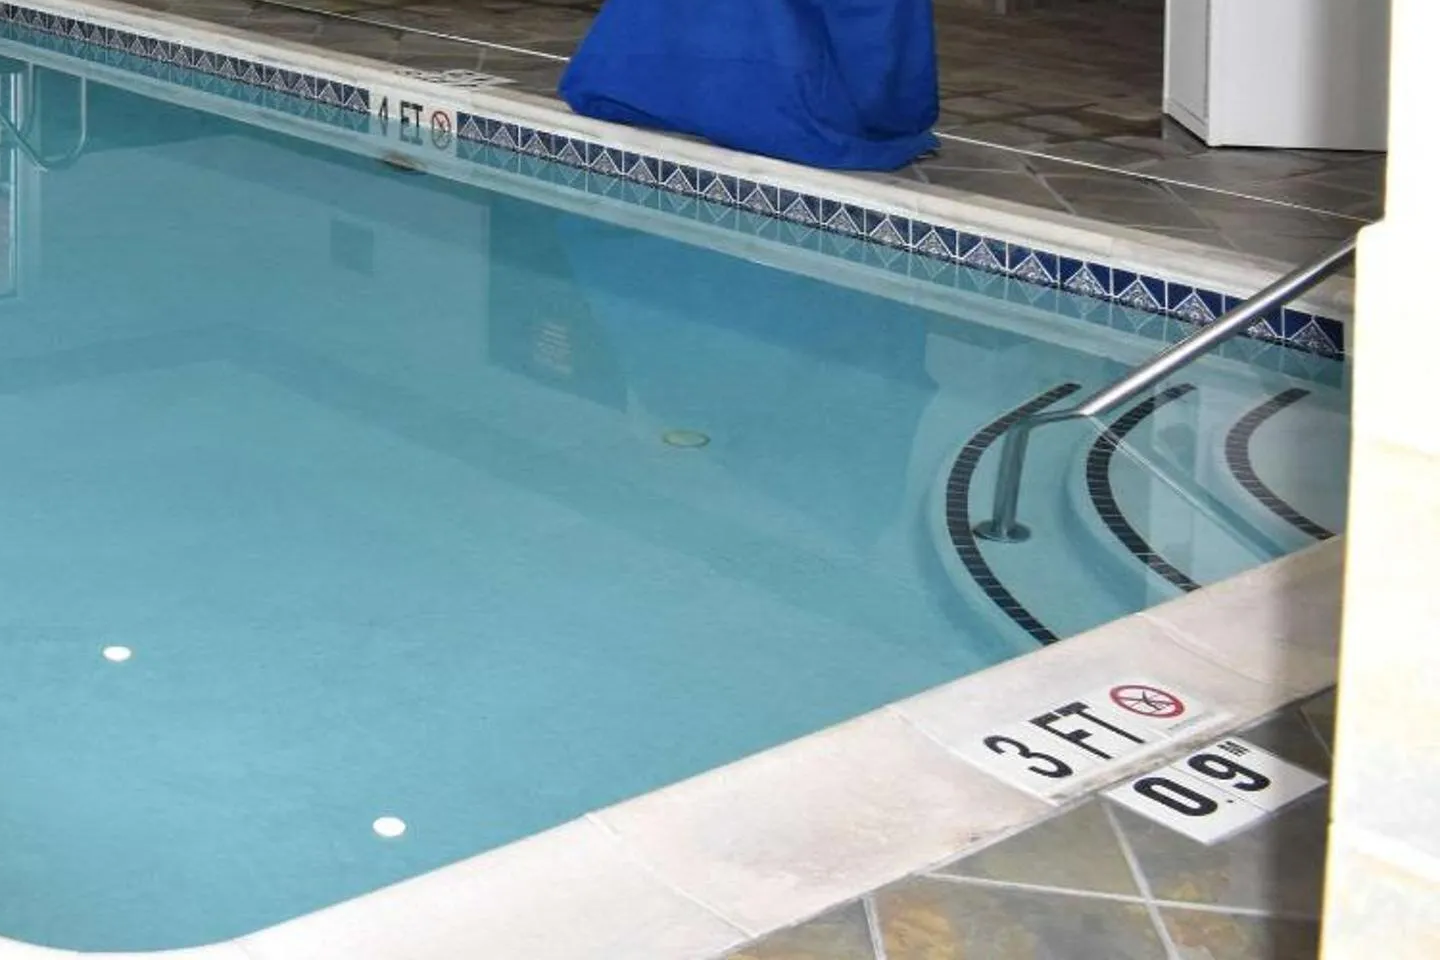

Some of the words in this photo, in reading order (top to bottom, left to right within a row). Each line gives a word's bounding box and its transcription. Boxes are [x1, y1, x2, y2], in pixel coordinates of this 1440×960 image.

[982, 734, 1074, 779] 3
[1028, 701, 1146, 760] FT
[1133, 753, 1271, 818] 0.9
